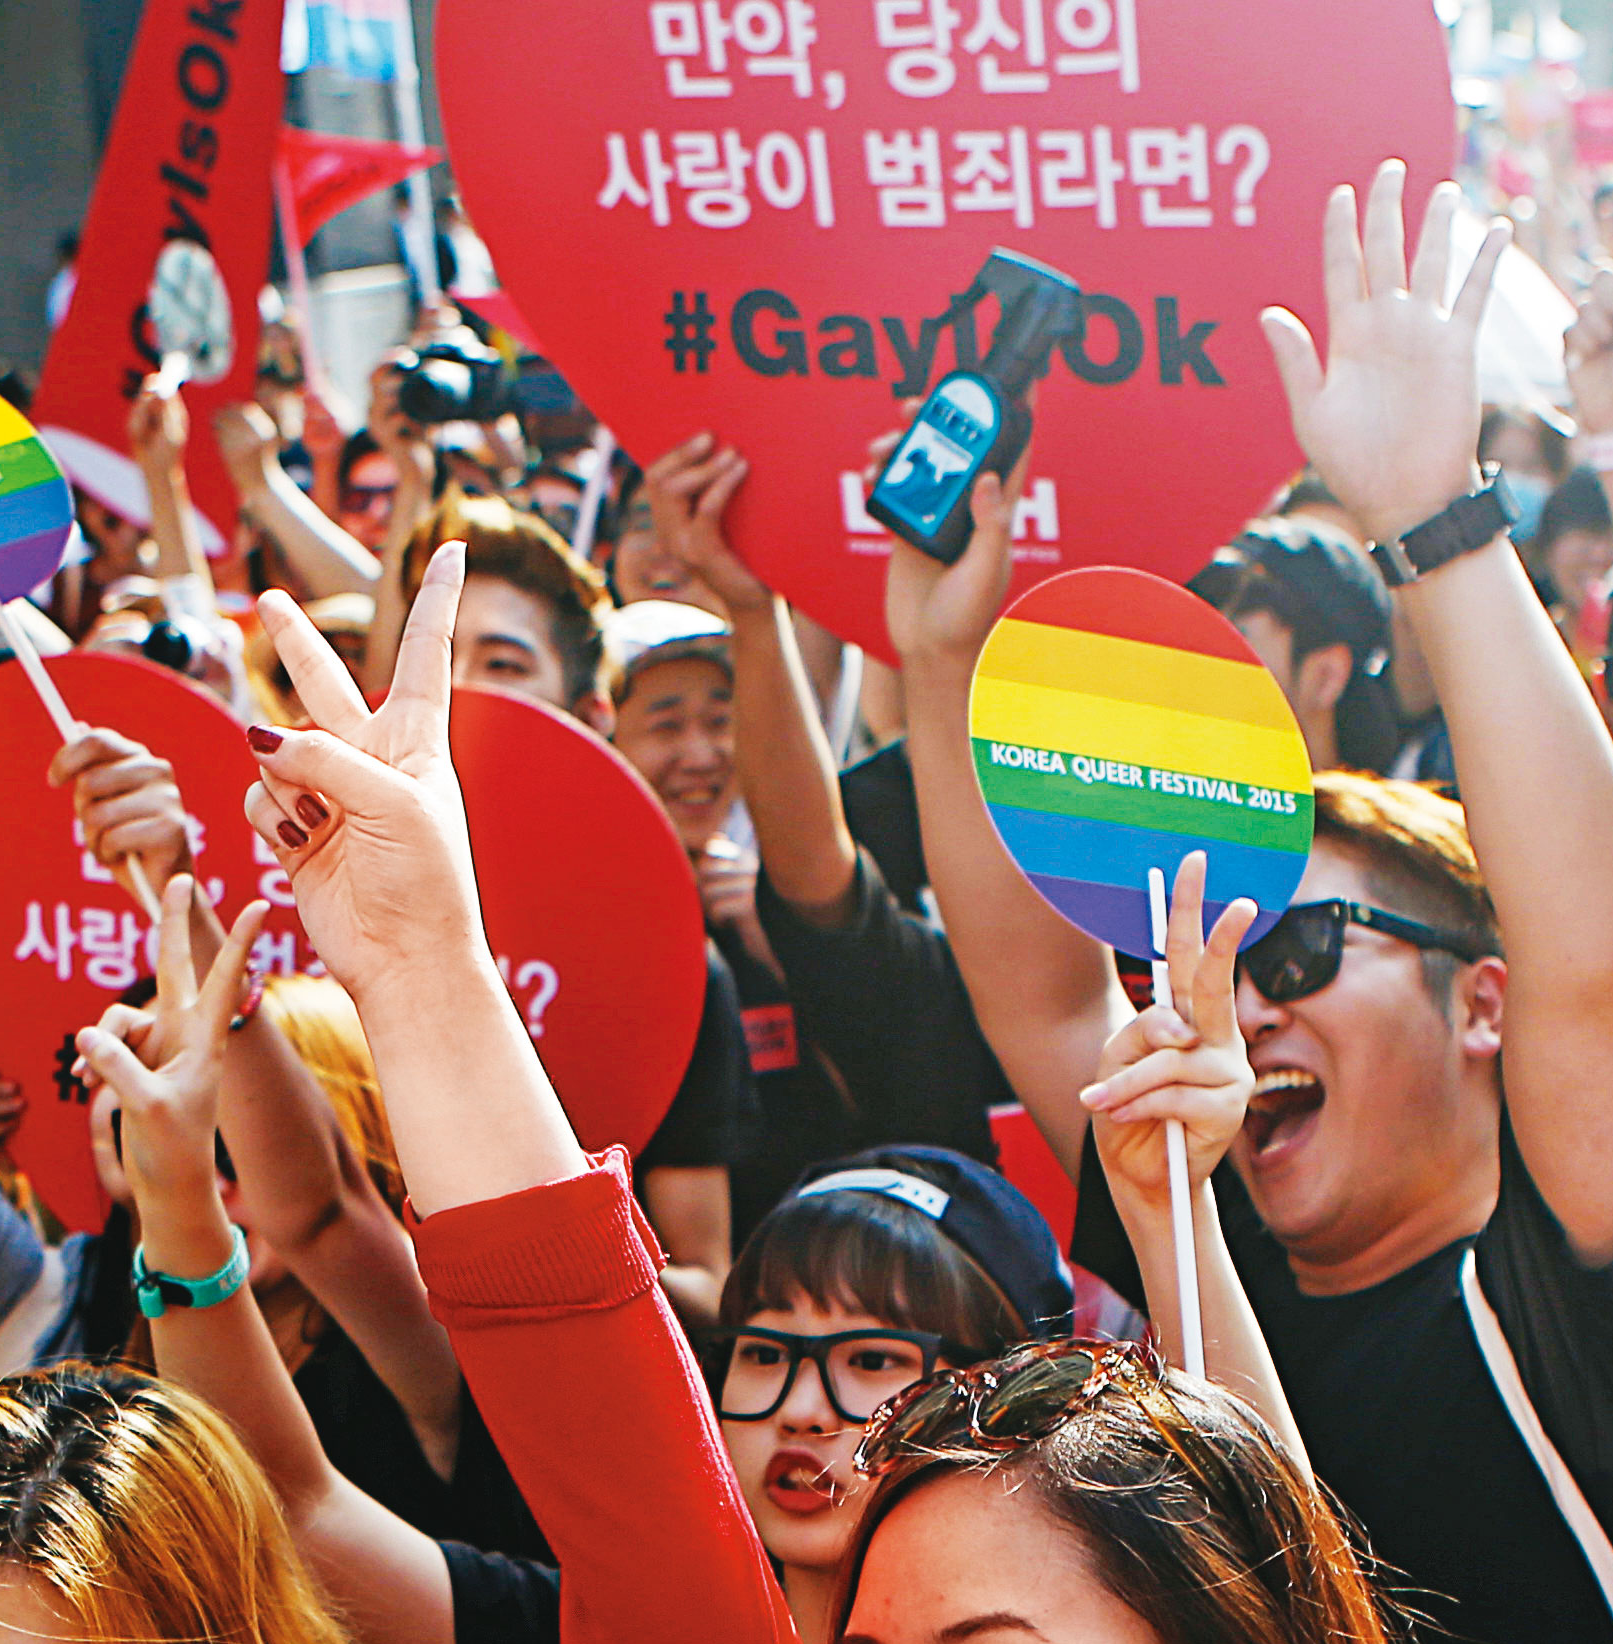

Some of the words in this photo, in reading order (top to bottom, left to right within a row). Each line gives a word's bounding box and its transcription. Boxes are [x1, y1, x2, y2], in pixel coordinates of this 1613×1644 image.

[648, 0, 848, 110] 만약,
[875, 0, 1142, 98] 당신의
[598, 127, 836, 228] 사랑이
[865, 124, 1273, 228] 범죄라면?
[663, 289, 1227, 399] #GayIOk
[841, 471, 1060, 541] LH
[990, 742, 1067, 776] KOREA
[1072, 754, 1145, 788] QUEER
[1148, 768, 1244, 805] FESTIVAL
[1248, 786, 1297, 815] 2015
[15, 899, 163, 990] 사랑
